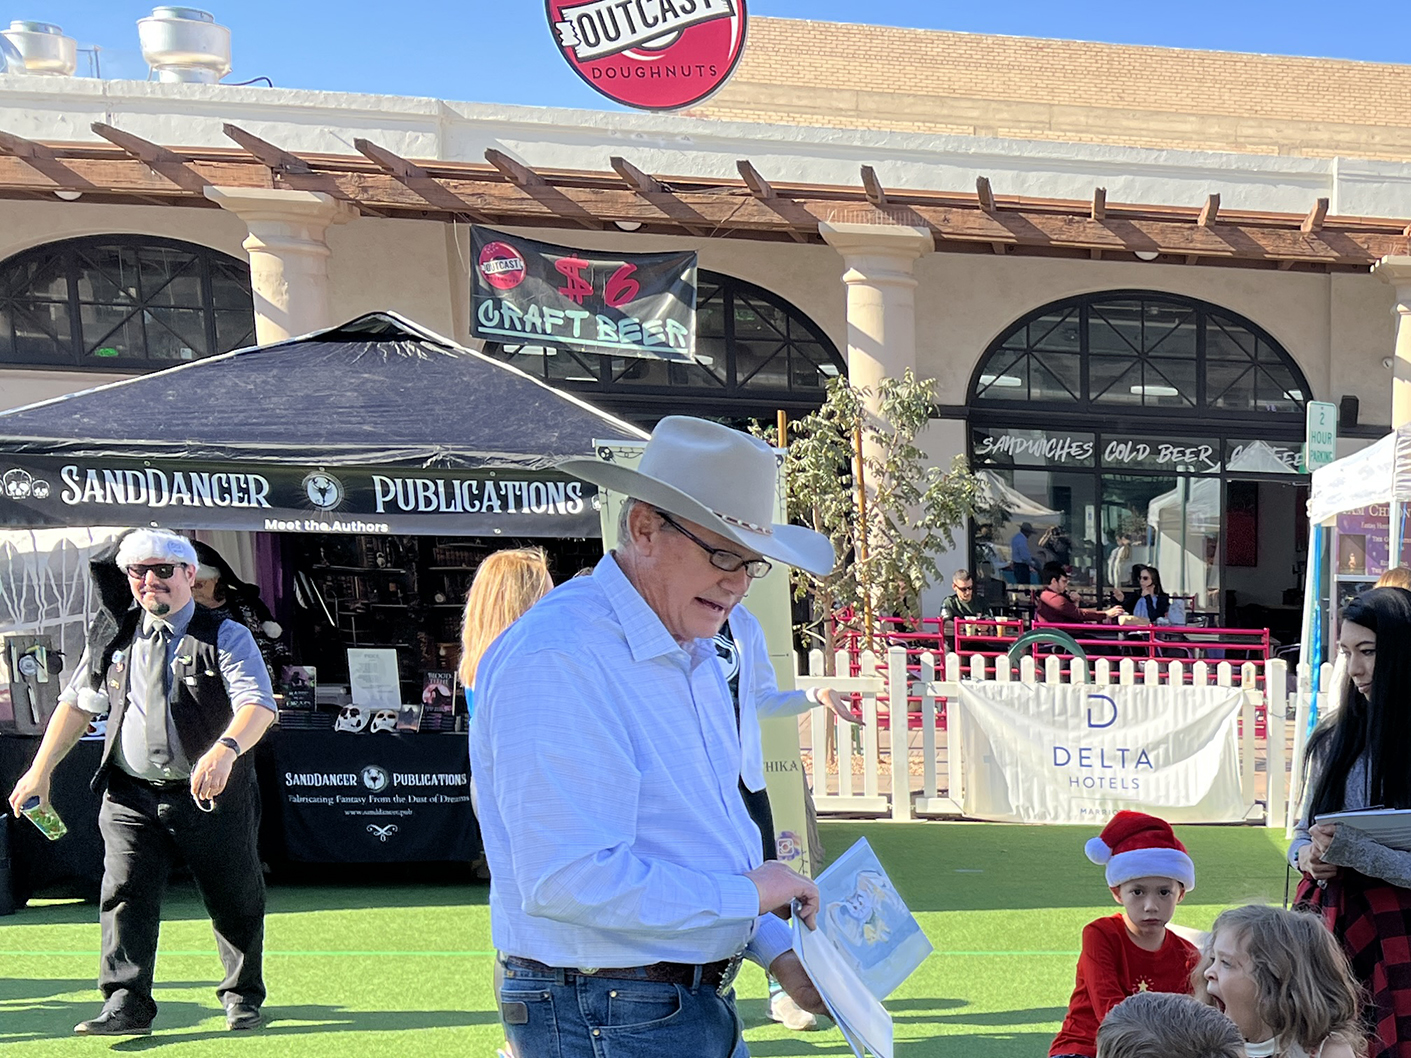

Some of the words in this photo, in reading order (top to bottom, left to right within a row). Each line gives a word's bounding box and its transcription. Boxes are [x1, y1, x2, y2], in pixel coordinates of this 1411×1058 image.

[576, 0, 713, 48] OUTCA
[592, 65, 718, 79] DOUGHNUTS
[485, 258, 520, 272] OUTCAST
[478, 299, 590, 338] CRAFT
[596, 314, 689, 348] BEER
[1320, 412, 1325, 426] 2
[1311, 431, 1333, 445] HOUR
[978, 435, 1094, 463] SANDWICHES
[1104, 440, 1151, 463] COLD
[1156, 443, 1216, 466] BEER
[1231, 444, 1304, 467] CFEE
[1310, 450, 1333, 463] PARKING
[372, 475, 584, 515] PUBLICATIONS
[264, 519, 301, 531] Meet
[304, 520, 331, 532] the
[332, 521, 389, 533] Authors
[1087, 694, 1118, 728] D
[1053, 746, 1154, 769] DELTA
[763, 760, 799, 773] HIKA
[393, 772, 468, 787] PUBLICATIONS
[1069, 776, 1140, 790] HOTELS
[288, 793, 335, 806] Fabricating
[336, 794, 367, 806] Fantasy
[368, 794, 391, 804] From
[393, 793, 406, 804] the
[408, 794, 428, 804] Dust
[429, 793, 439, 804] of
[440, 794, 470, 804] Dreams
[1080, 807, 1120, 816] MARRIO
